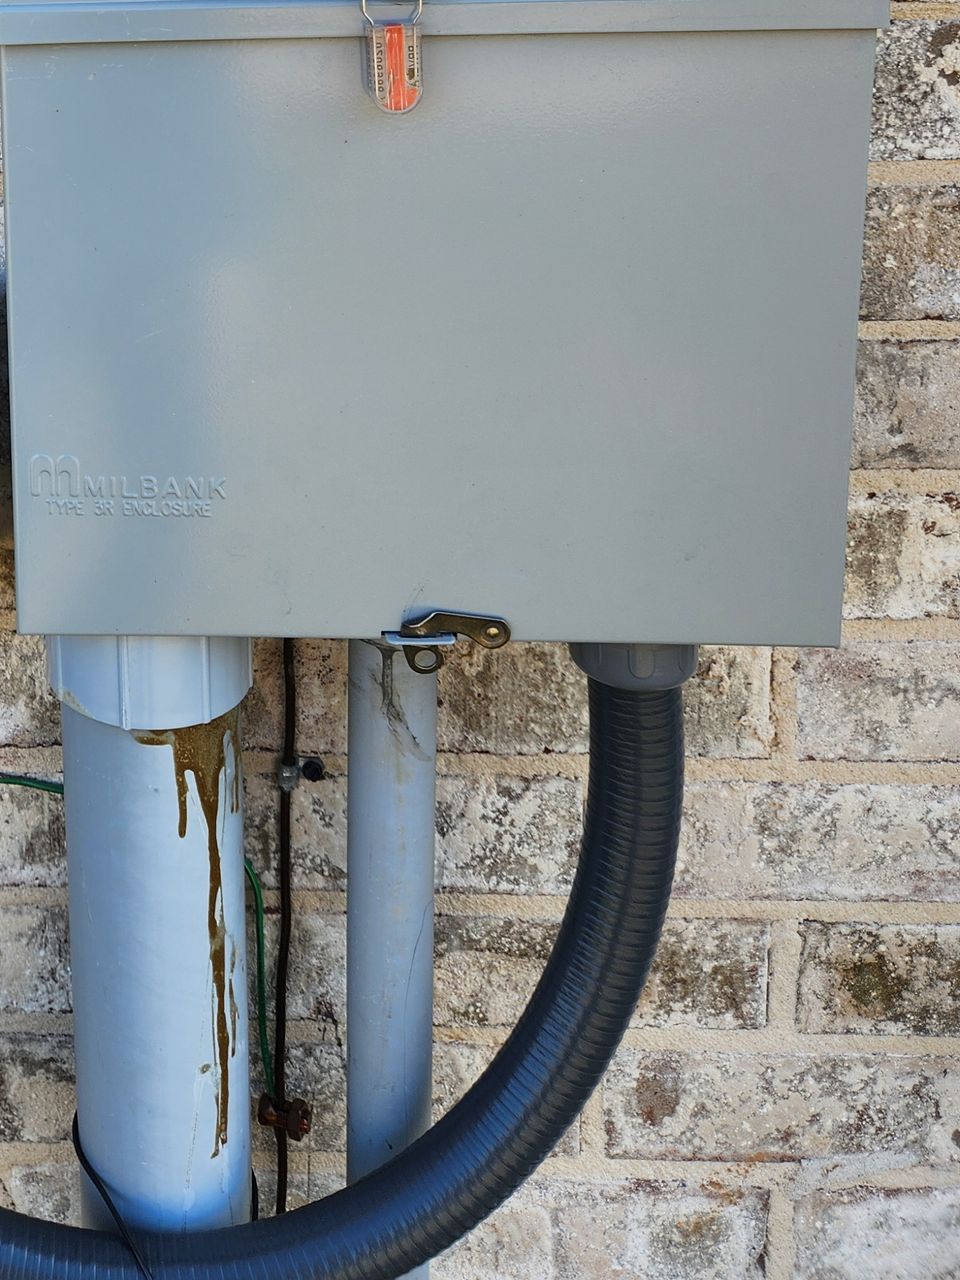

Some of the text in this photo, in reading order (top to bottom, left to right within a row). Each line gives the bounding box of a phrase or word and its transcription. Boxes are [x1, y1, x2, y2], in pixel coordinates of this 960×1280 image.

[84, 475, 227, 499] MILBANK
[46, 499, 213, 518] TYPE 3R ENCLOSURE
